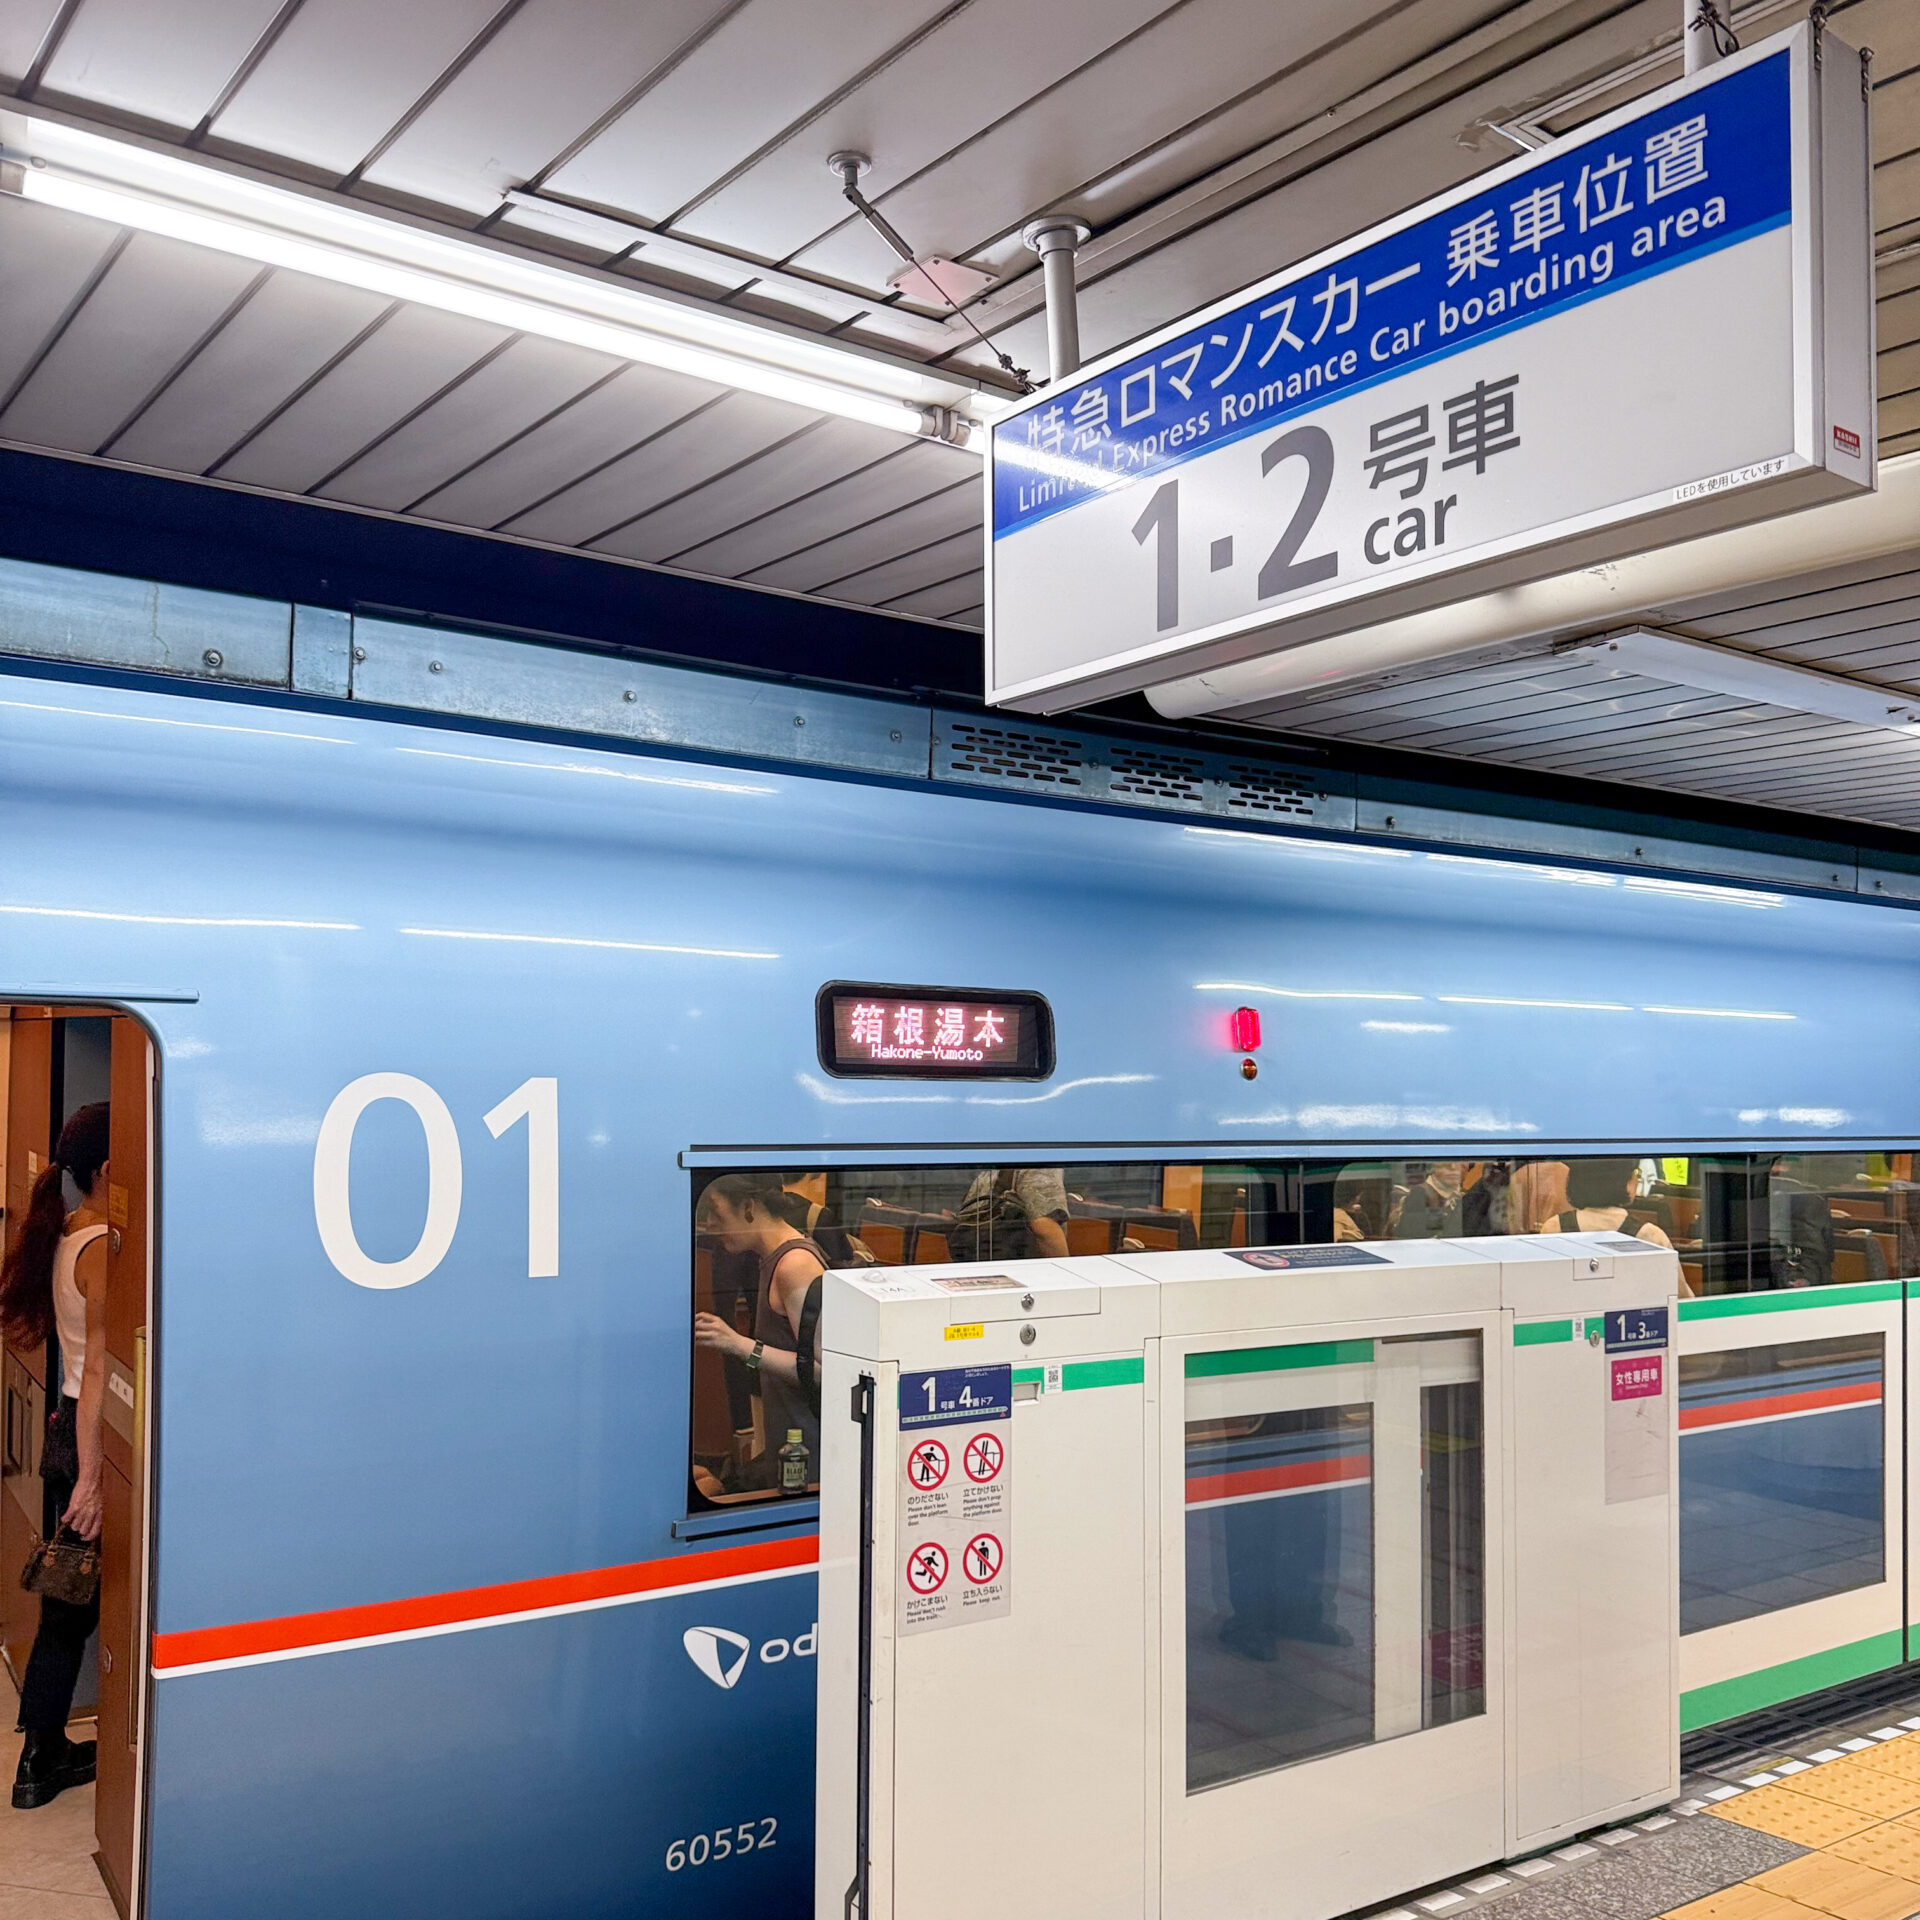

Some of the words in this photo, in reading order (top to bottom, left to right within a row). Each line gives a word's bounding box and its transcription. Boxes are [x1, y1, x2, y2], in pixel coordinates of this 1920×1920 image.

[1027, 262, 1421, 456] 特急ロマンスカー
[1446, 113, 1709, 288] 乗車位置
[1113, 411, 1211, 473] Express
[1221, 349, 1358, 427] Romance
[1369, 318, 1426, 363] Car
[1438, 240, 1615, 337] boarding
[1631, 195, 1726, 257] area
[1676, 459, 1785, 500] LEDを使用しています
[1363, 494, 1457, 565] car
[851, 1003, 1005, 1048] 箱根湯本
[871, 1043, 984, 1061] Hakone-Yumoto
[313, 1071, 559, 1290] 01
[665, 1817, 777, 1872] 60552
